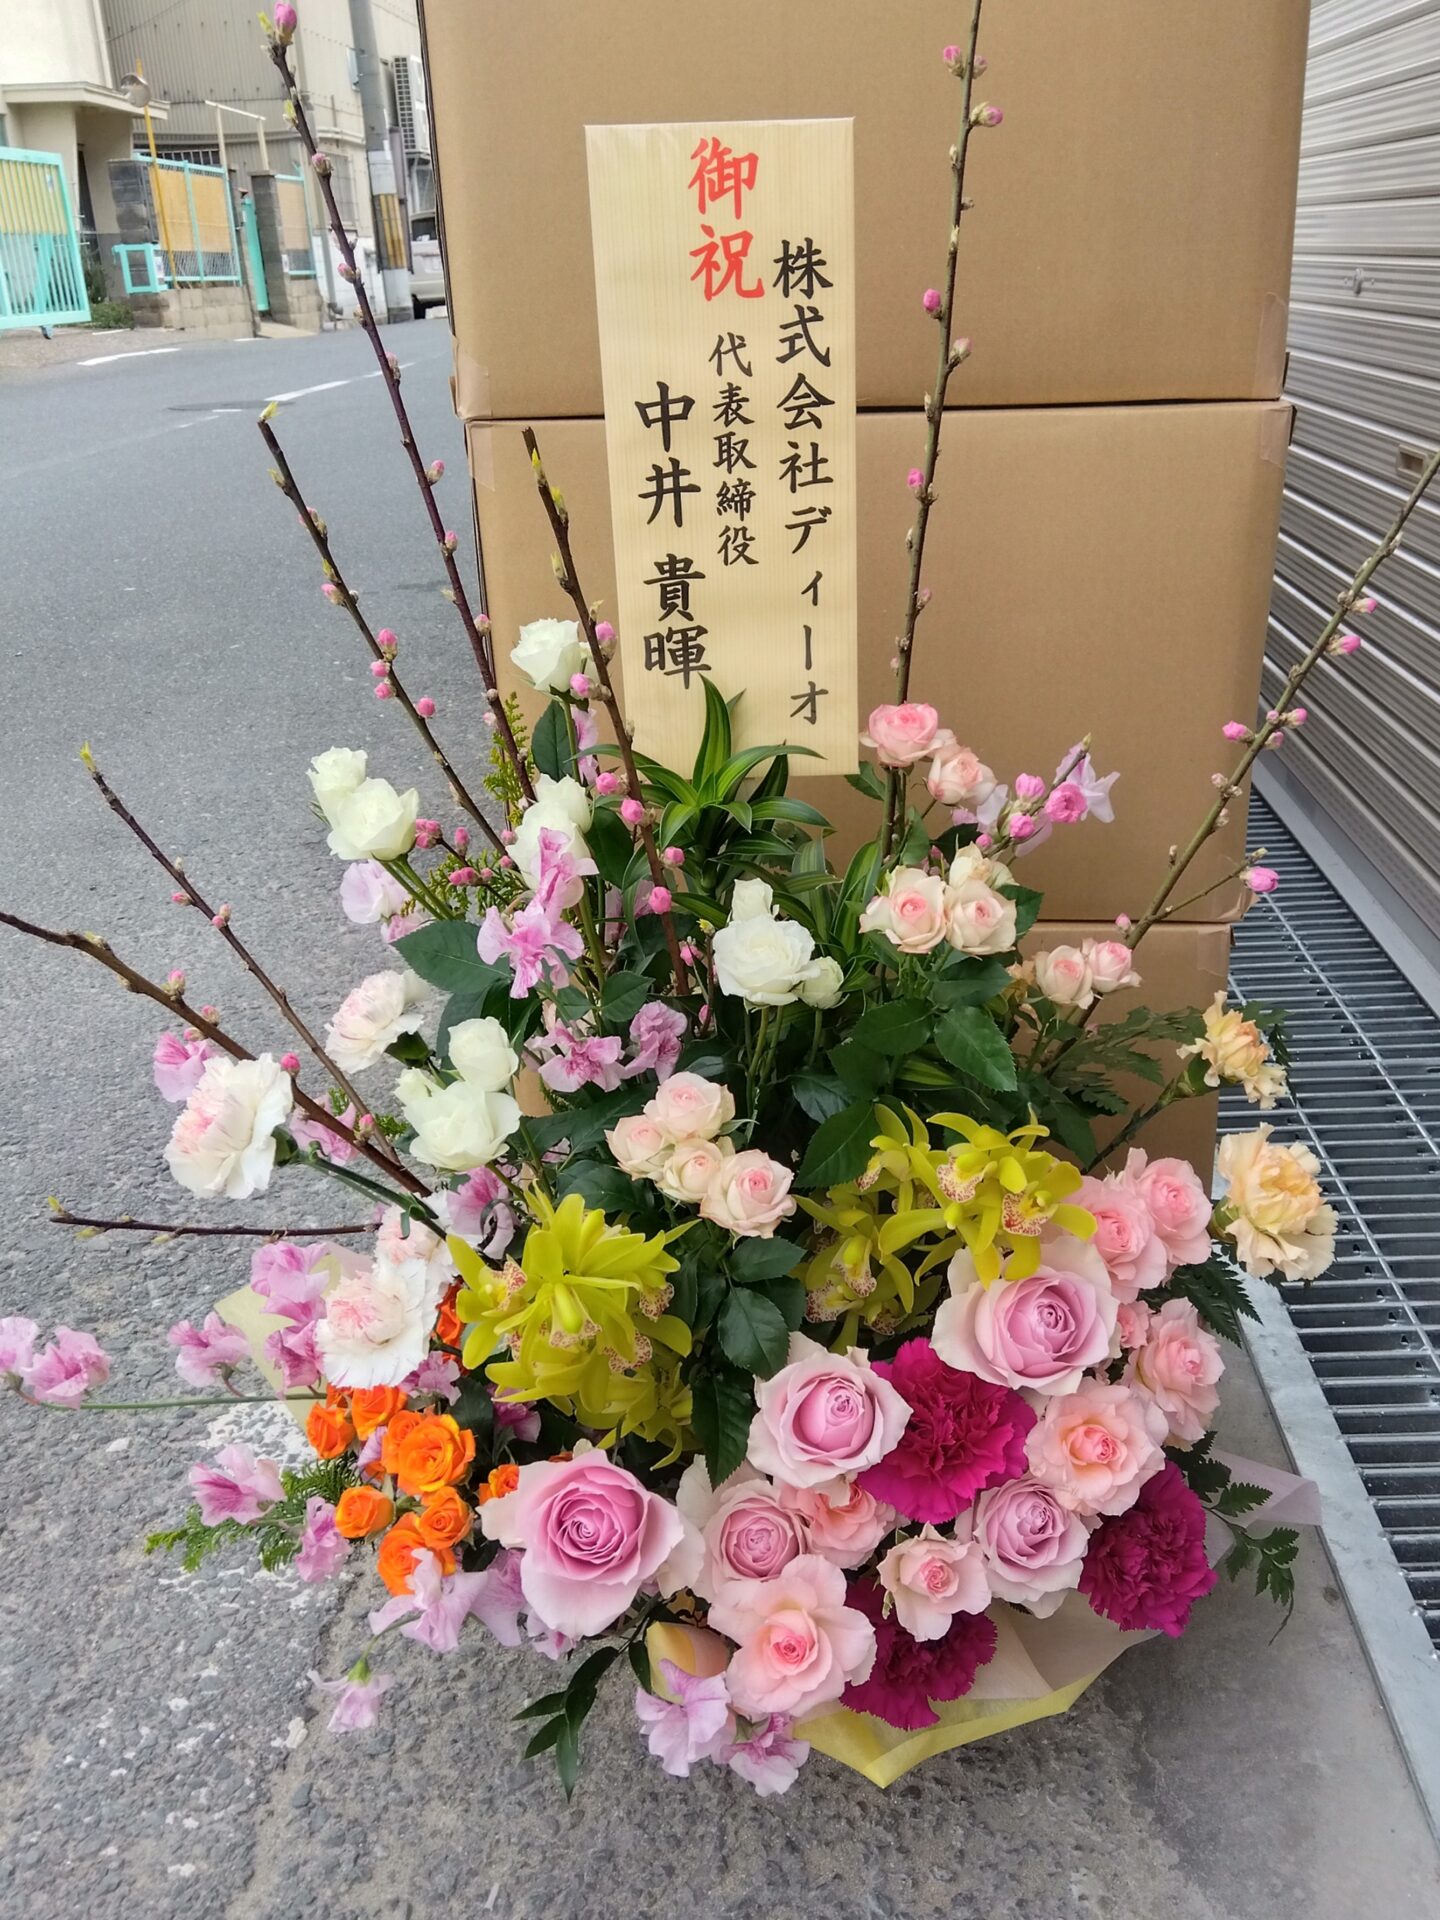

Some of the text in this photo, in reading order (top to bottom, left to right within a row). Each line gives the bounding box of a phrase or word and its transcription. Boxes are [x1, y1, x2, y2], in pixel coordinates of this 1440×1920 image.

[688, 136, 765, 302] 御祝
[708, 332, 760, 567] 代表取締役
[772, 237, 836, 725] 株式会社ディーオ
